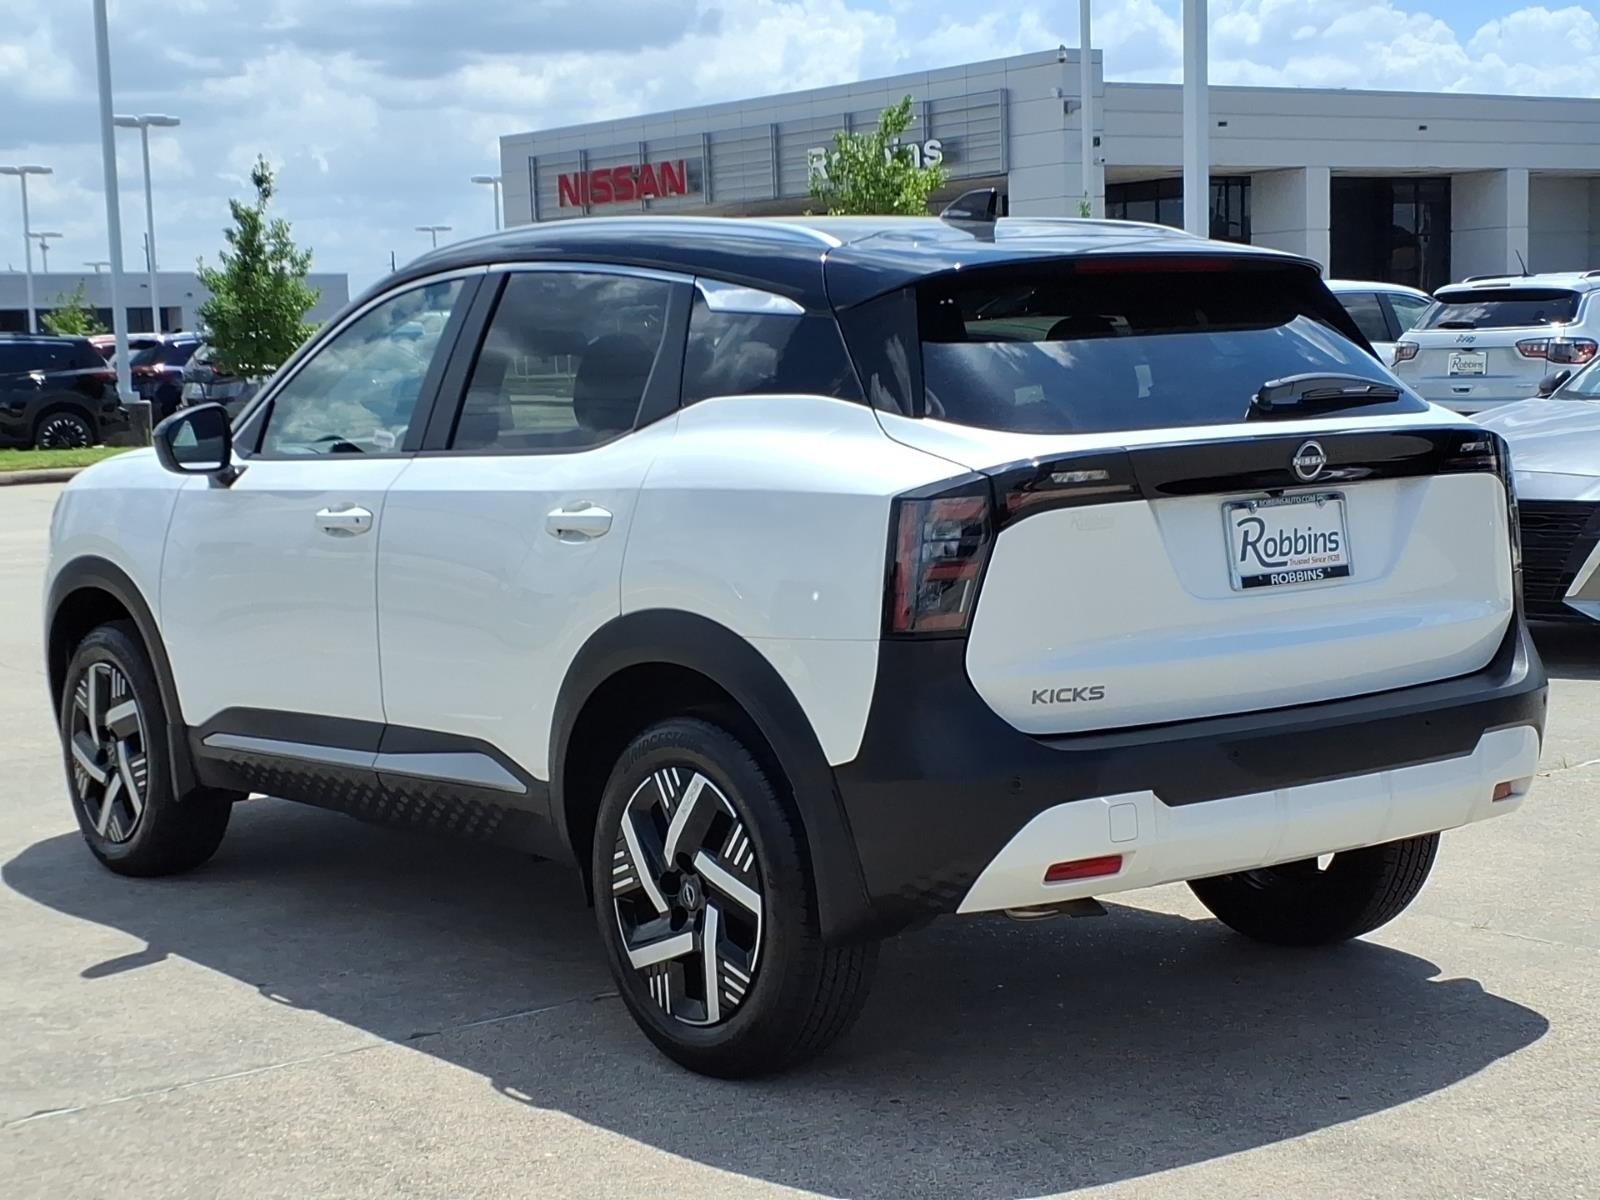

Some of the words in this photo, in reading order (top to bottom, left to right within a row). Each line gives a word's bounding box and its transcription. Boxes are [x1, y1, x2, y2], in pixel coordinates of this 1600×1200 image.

[556, 160, 687, 207] NISSAN
[1293, 455, 1327, 466] NISSAN
[1236, 516, 1339, 568] Robbins
[1271, 568, 1324, 585] ROBBINS
[1031, 685, 1105, 704] KICKS
